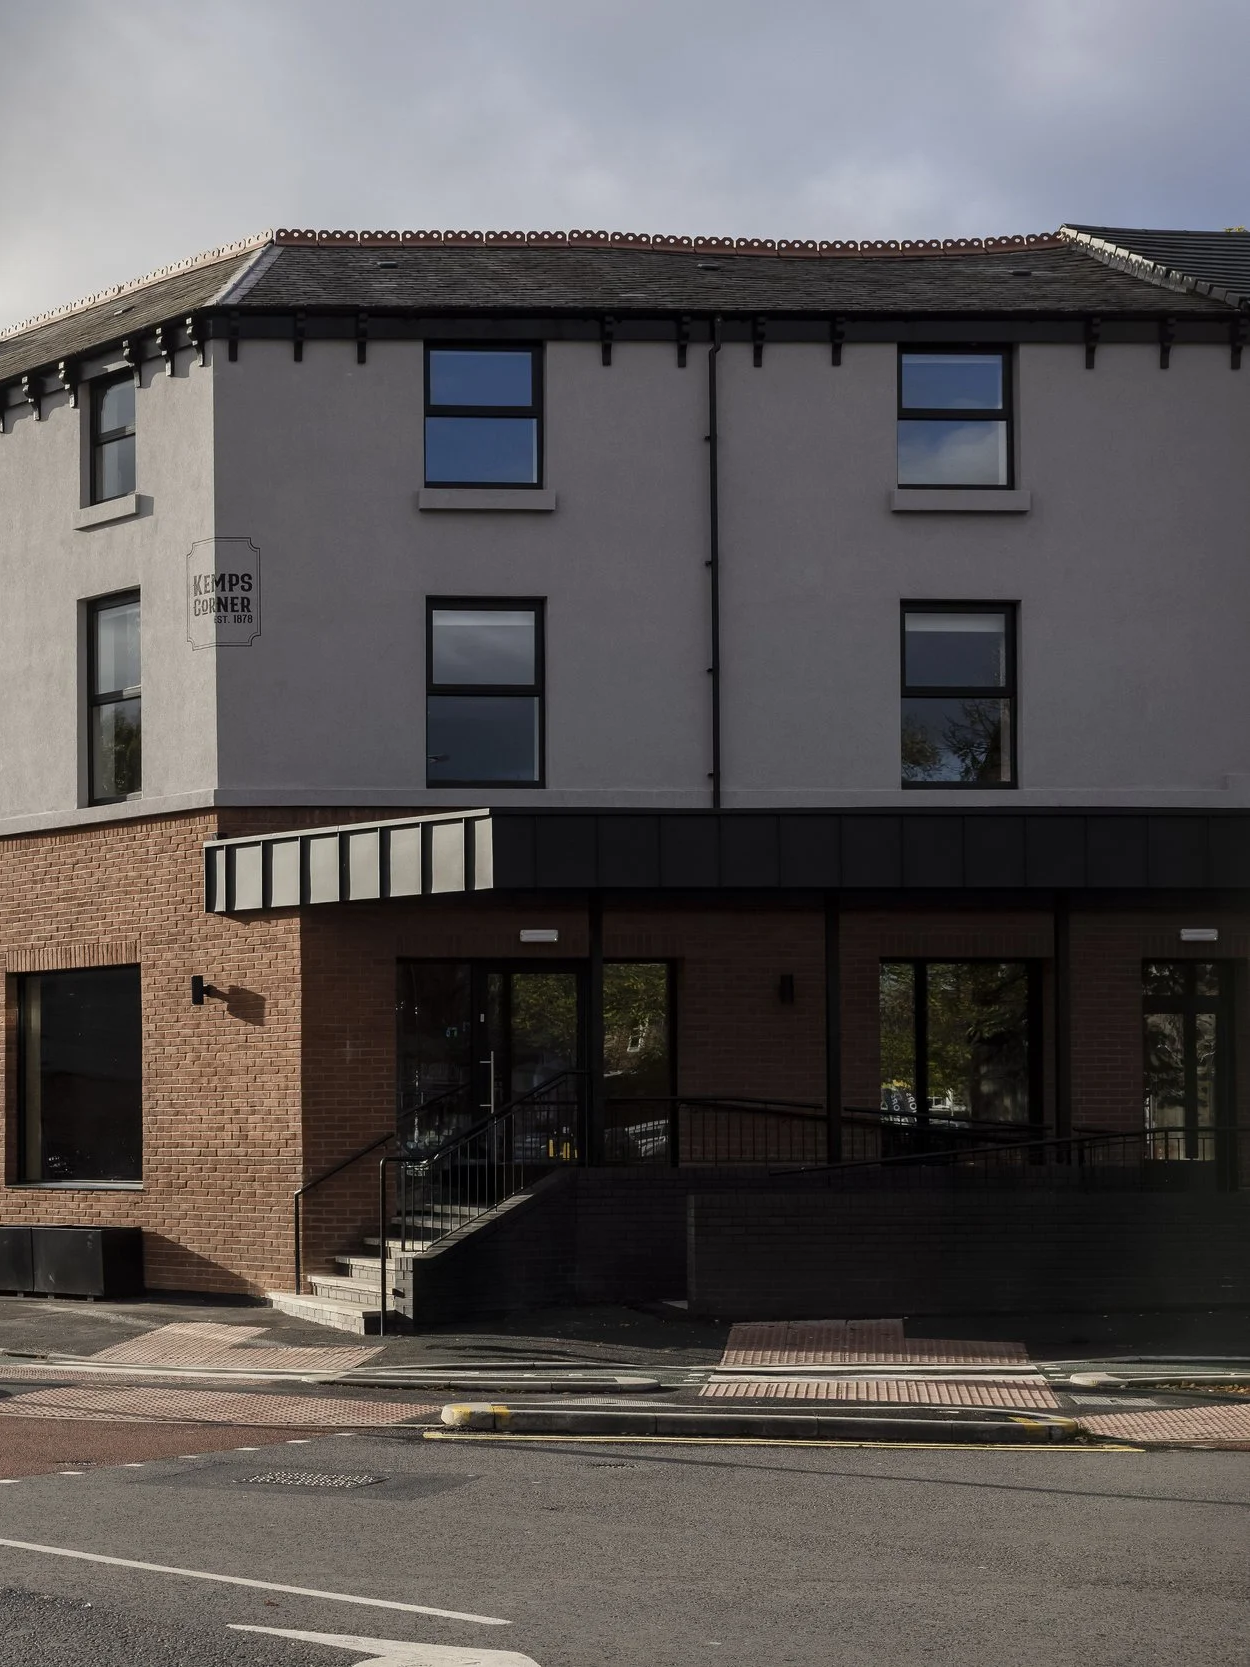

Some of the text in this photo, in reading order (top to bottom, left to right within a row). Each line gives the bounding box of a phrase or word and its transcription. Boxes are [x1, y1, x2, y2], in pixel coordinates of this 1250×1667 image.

[193, 573, 253, 596] KEMPS
[193, 596, 251, 616] CORNER
[233, 614, 253, 624] 1878
